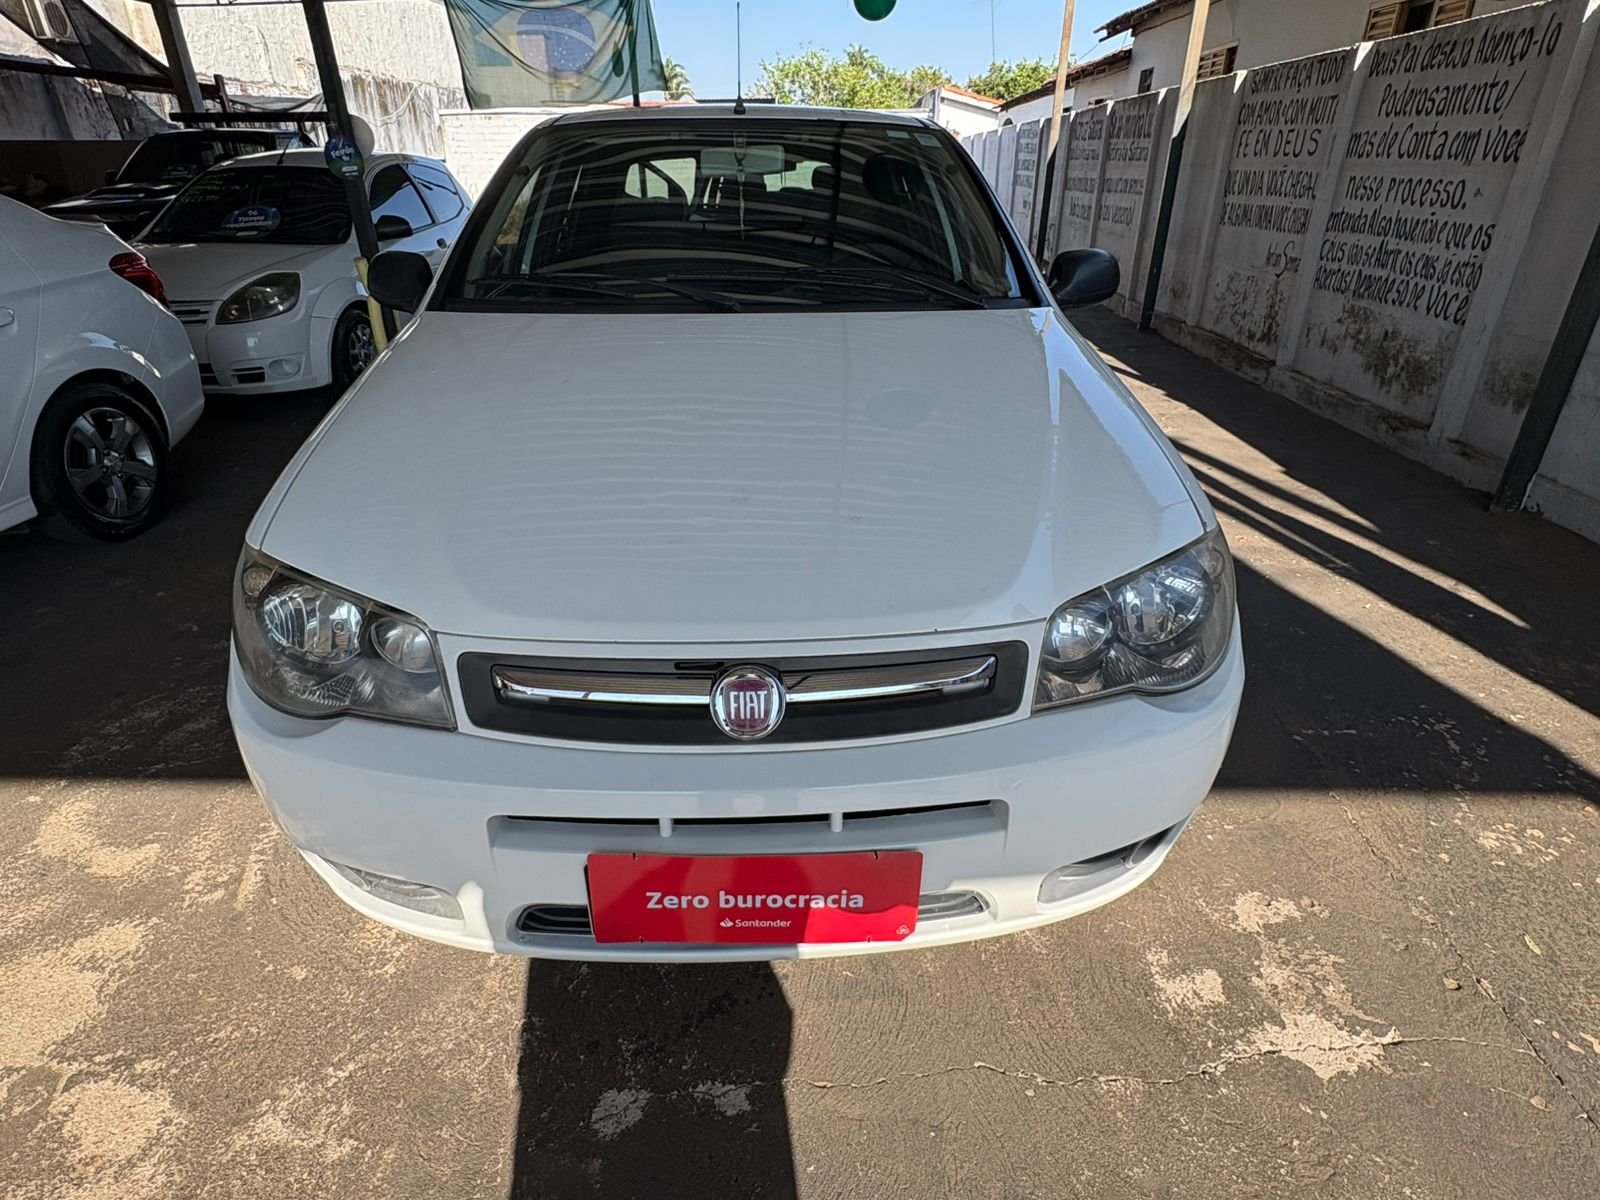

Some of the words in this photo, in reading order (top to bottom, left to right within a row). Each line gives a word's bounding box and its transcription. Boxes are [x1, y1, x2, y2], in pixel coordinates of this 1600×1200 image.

[1368, 47, 1400, 78] Deus
[1397, 35, 1425, 75] Pai
[1283, 60, 1314, 93] FAÇA
[1315, 55, 1347, 86] TUDO
[1238, 102, 1257, 125] COM
[1255, 99, 1283, 126] AMOR
[1284, 97, 1308, 125] COM
[1253, 128, 1273, 157] EM
[1273, 128, 1322, 158] DEUS
[1345, 129, 1377, 159] mas
[1375, 122, 1398, 159] ele
[1397, 121, 1449, 161] Conta
[1447, 128, 1483, 166] com
[1249, 169, 1265, 196] DIA
[1345, 175, 1384, 202] nesse
[1325, 205, 1368, 234] entenda
[1444, 219, 1474, 251] que
[1471, 223, 1497, 252] os
[1362, 243, 1378, 269] se
[1399, 250, 1416, 277] os
[729, 690, 768, 719] FIAT
[645, 891, 710, 909] Zero
[718, 889, 865, 909] burocracia
[734, 918, 793, 929] Santander
